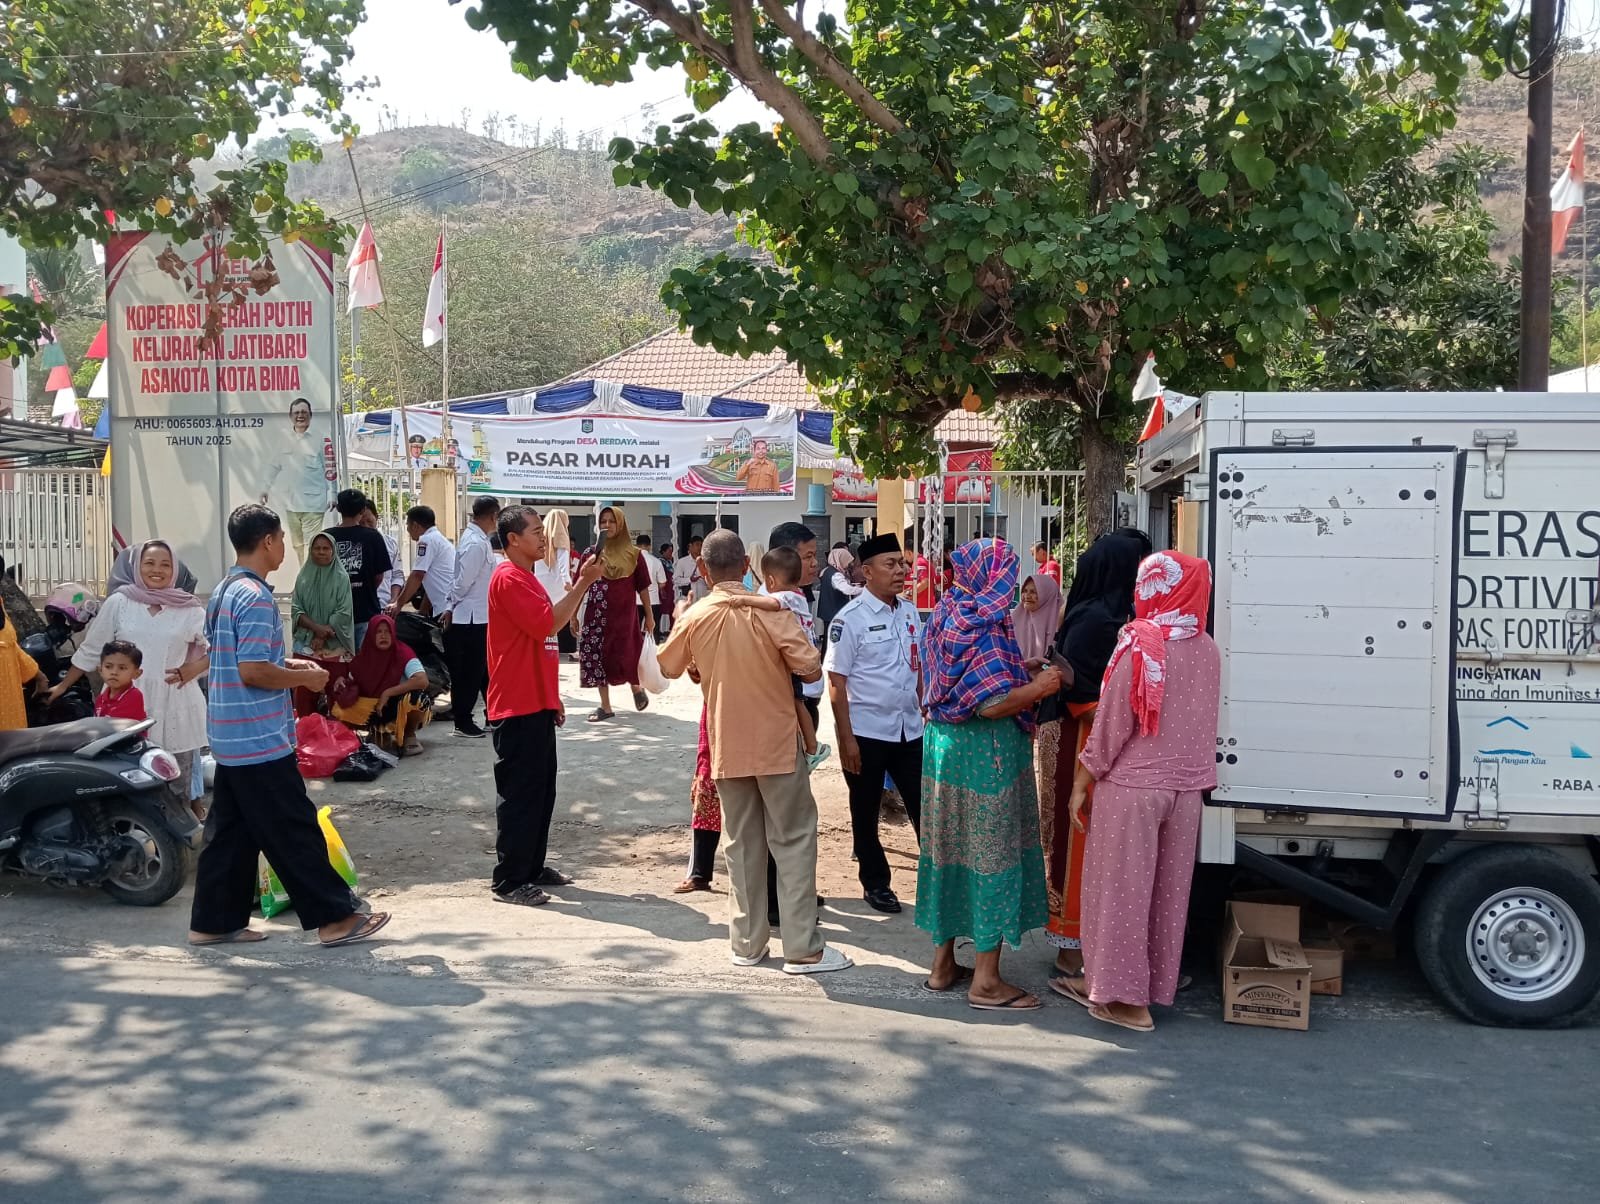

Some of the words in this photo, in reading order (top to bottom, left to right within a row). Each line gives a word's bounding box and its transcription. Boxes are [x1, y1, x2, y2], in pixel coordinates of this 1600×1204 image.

[126, 303, 200, 331] KOPERASI
[264, 301, 313, 327] PUTIH
[228, 333, 307, 360] JATIBARU
[141, 366, 210, 393] ASAKOTA
[216, 365, 257, 391] KOTA
[259, 365, 301, 391] BIMA
[134, 418, 164, 430] AHU:
[166, 418, 264, 429] 0065603.AH.01.29
[166, 436, 203, 446] TAHUN
[206, 435, 232, 446] 2025
[576, 437, 598, 446] DESA
[599, 438, 638, 446] BERDAYA
[506, 451, 579, 468] PASAR
[586, 453, 670, 469] MURAH
[1552, 779, 1594, 791] RABA
